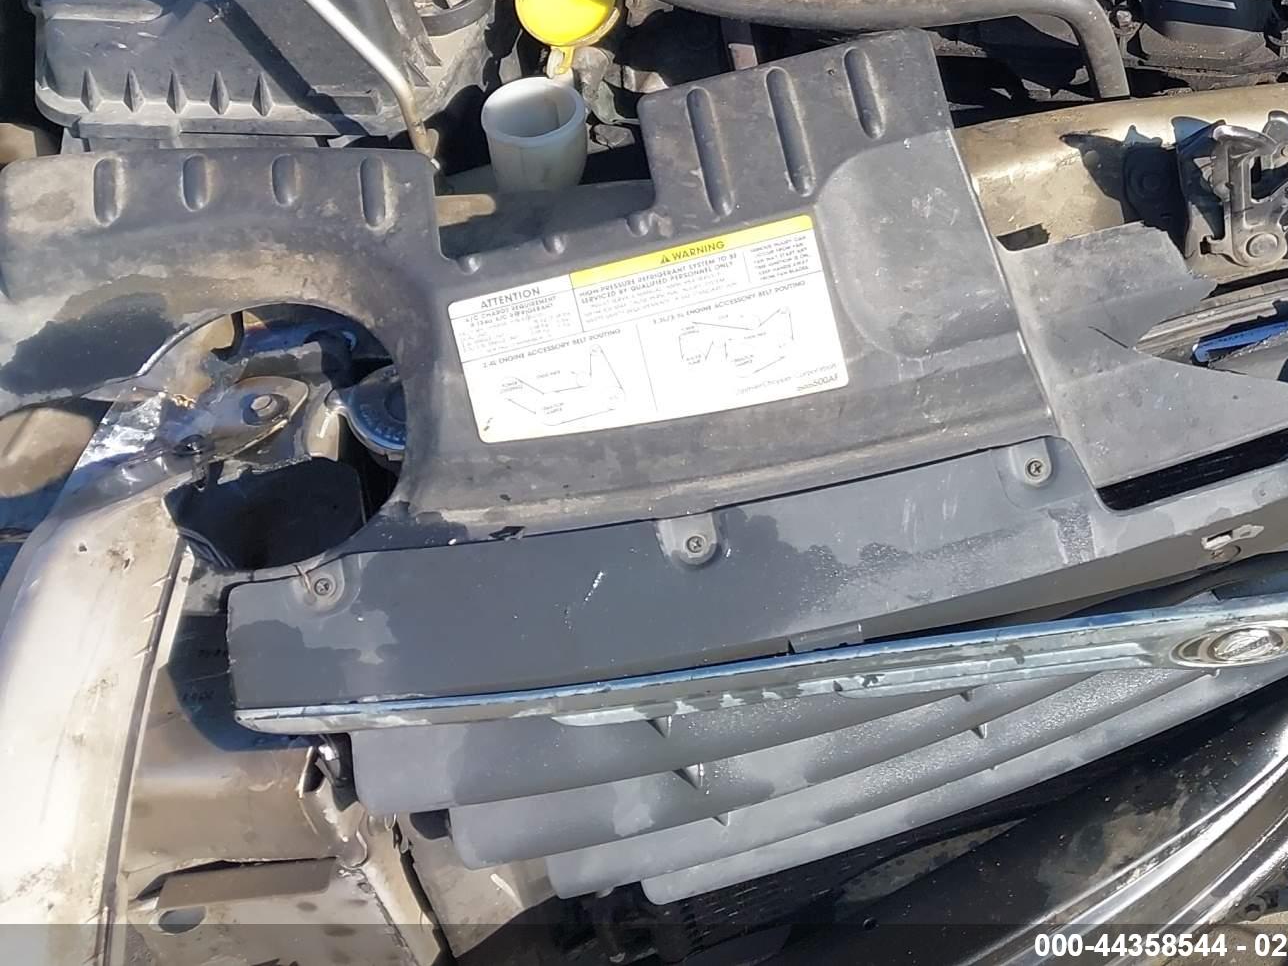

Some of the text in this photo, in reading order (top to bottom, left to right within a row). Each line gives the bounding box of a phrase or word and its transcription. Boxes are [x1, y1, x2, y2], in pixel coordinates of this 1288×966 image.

[671, 240, 725, 260] WARNING
[479, 286, 541, 308] ATTENTION
[526, 341, 570, 356] ACCESSORY
